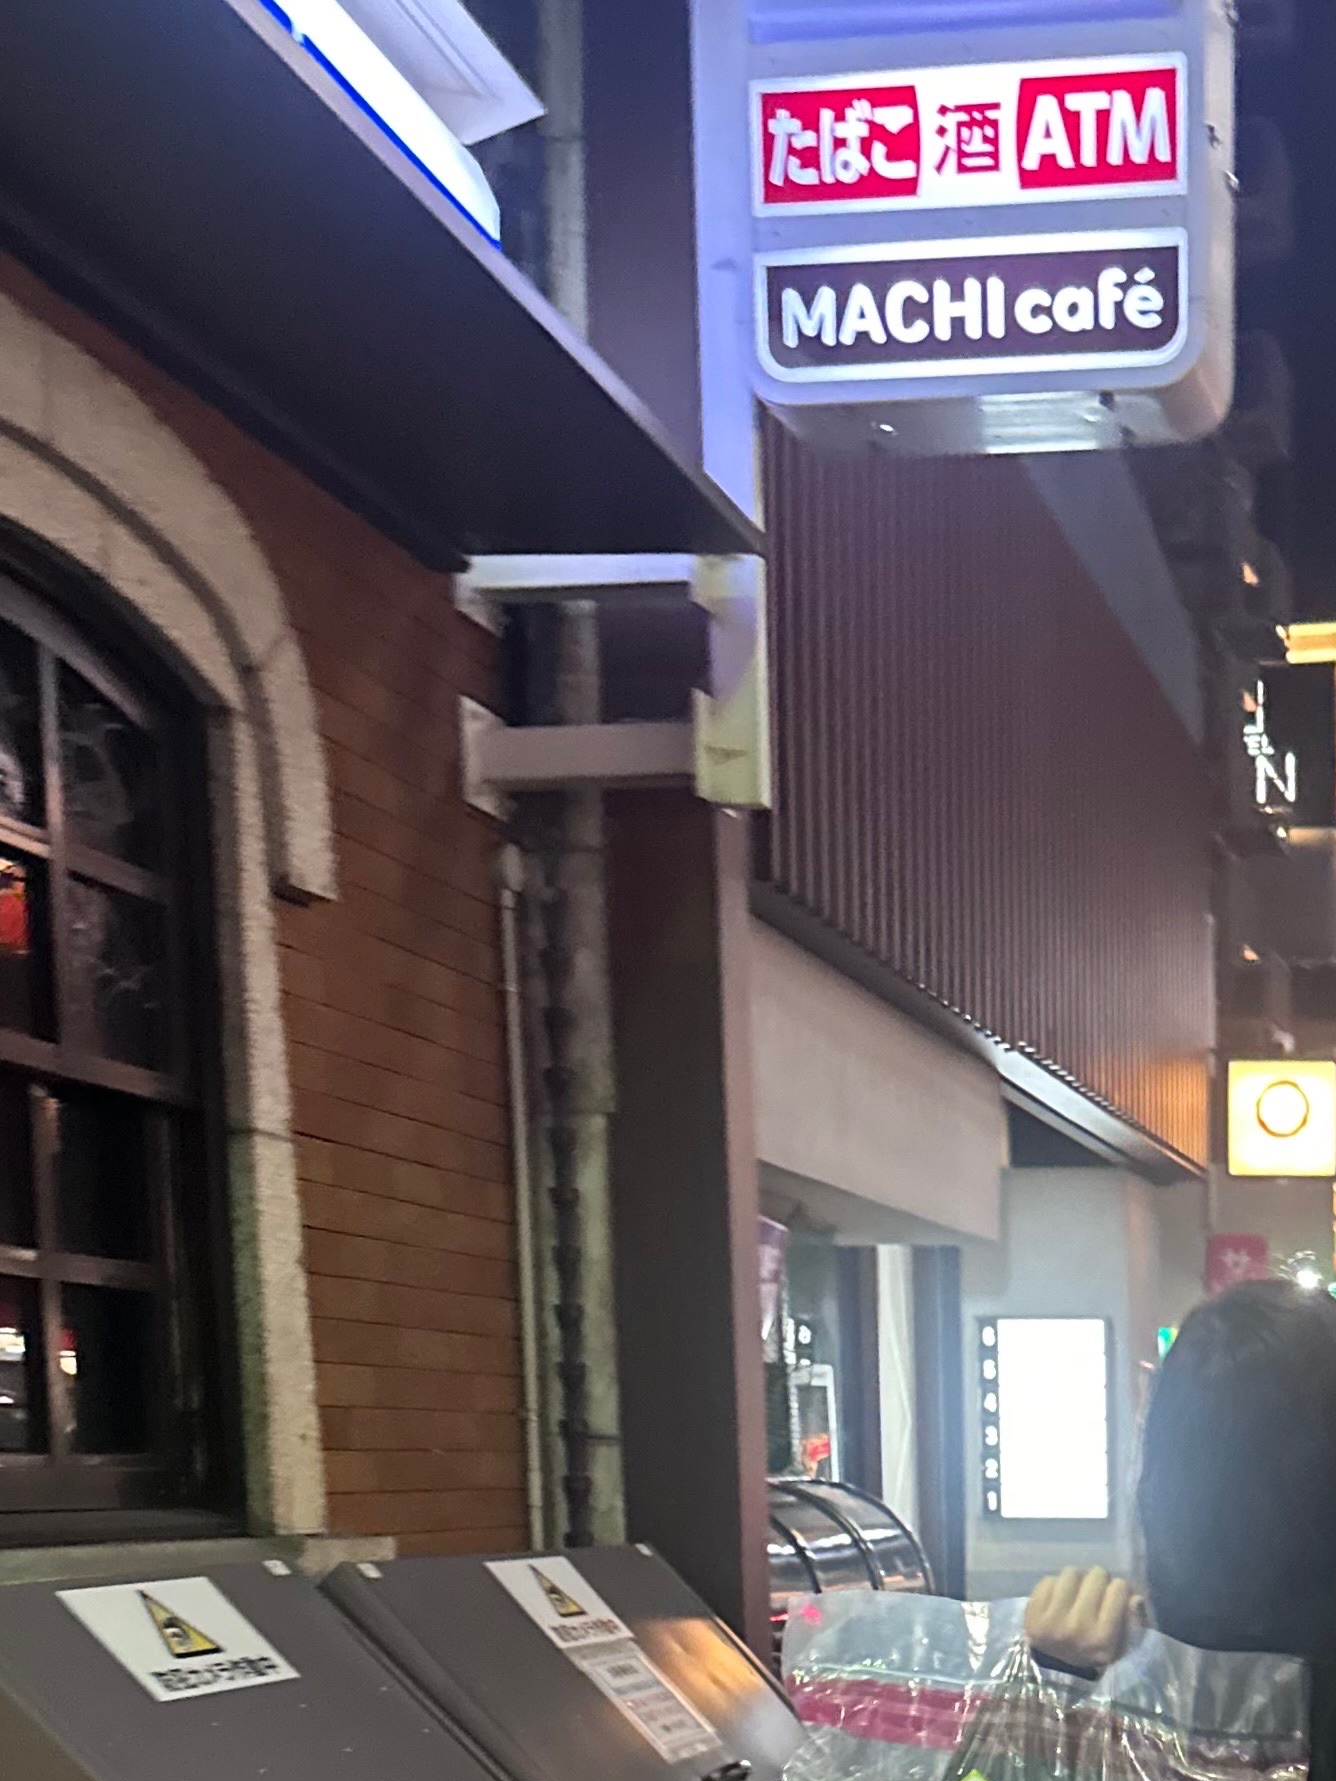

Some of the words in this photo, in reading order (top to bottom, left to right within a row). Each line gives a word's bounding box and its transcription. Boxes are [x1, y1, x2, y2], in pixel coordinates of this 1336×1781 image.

[768, 99, 918, 186] たばこ
[934, 101, 1001, 176] 酒
[1020, 87, 1172, 171] ATM
[781, 275, 1006, 349] MACHI
[1013, 266, 1165, 335] café
